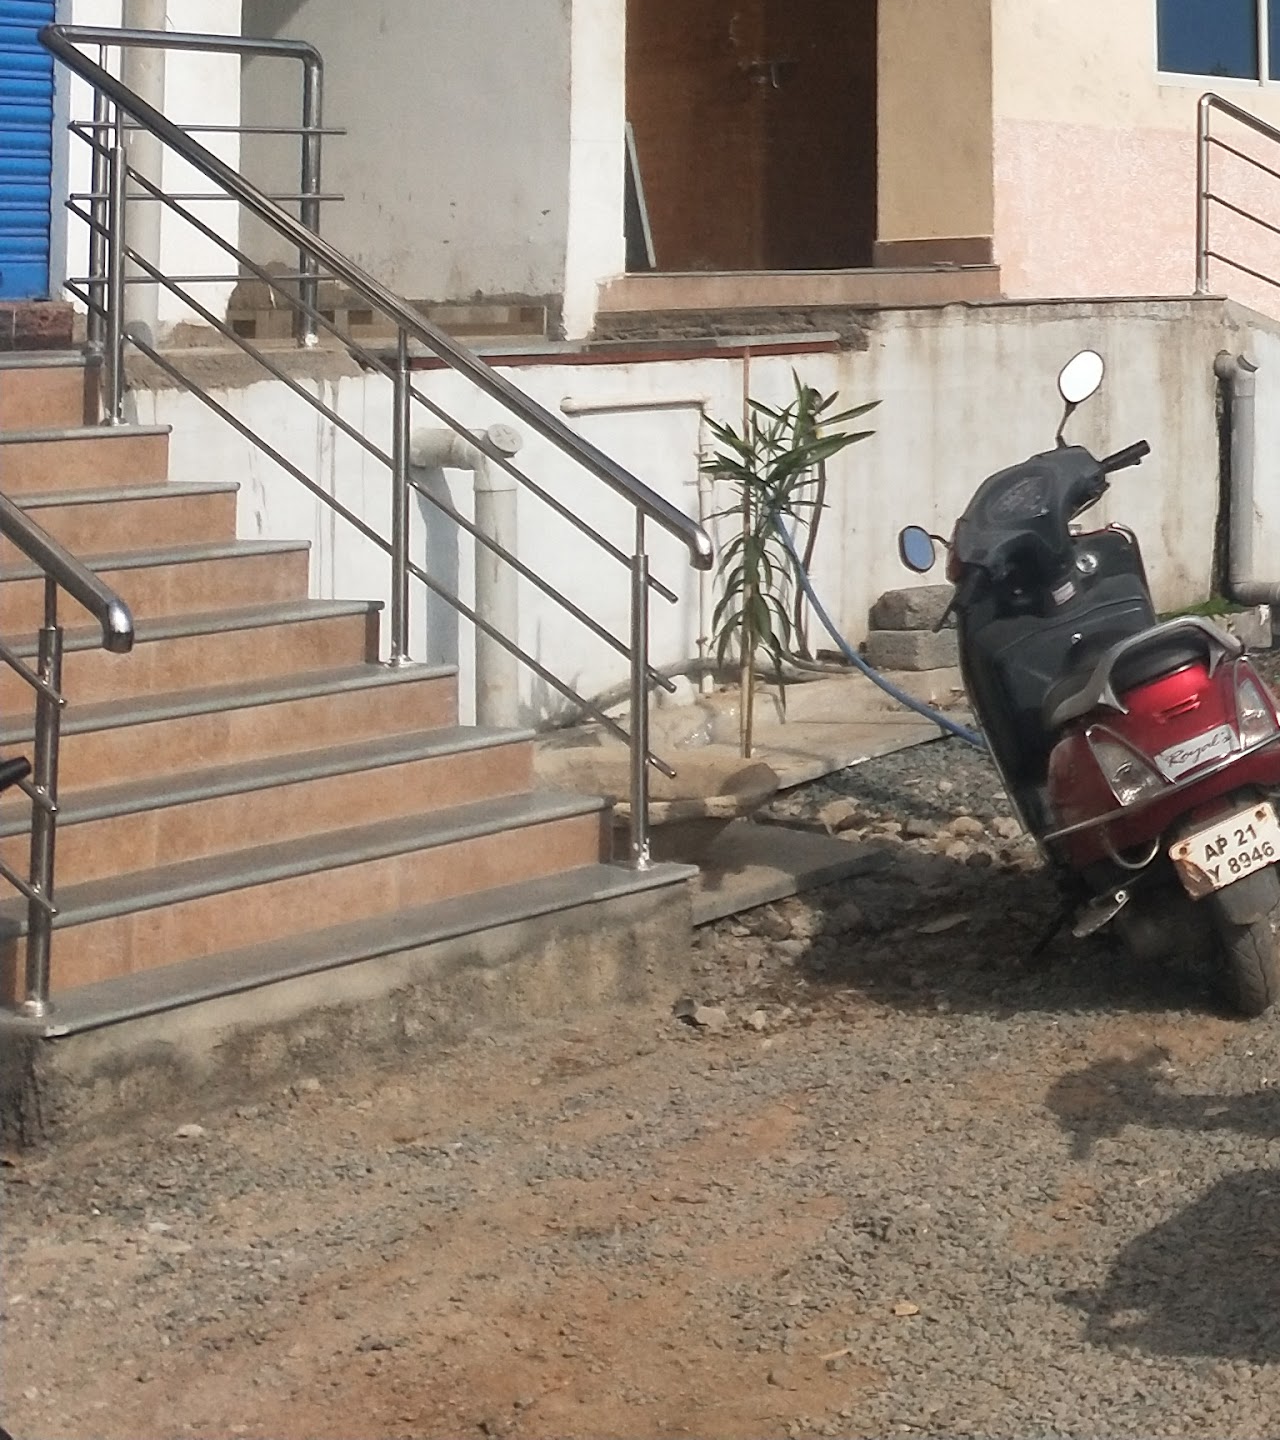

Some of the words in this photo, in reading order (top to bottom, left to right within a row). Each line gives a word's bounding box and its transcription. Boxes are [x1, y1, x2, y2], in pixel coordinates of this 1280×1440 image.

[1204, 834, 1228, 862] AP
[1234, 824, 1257, 847] 21
[1207, 865, 1221, 883] Y
[1227, 841, 1275, 874] 8946
